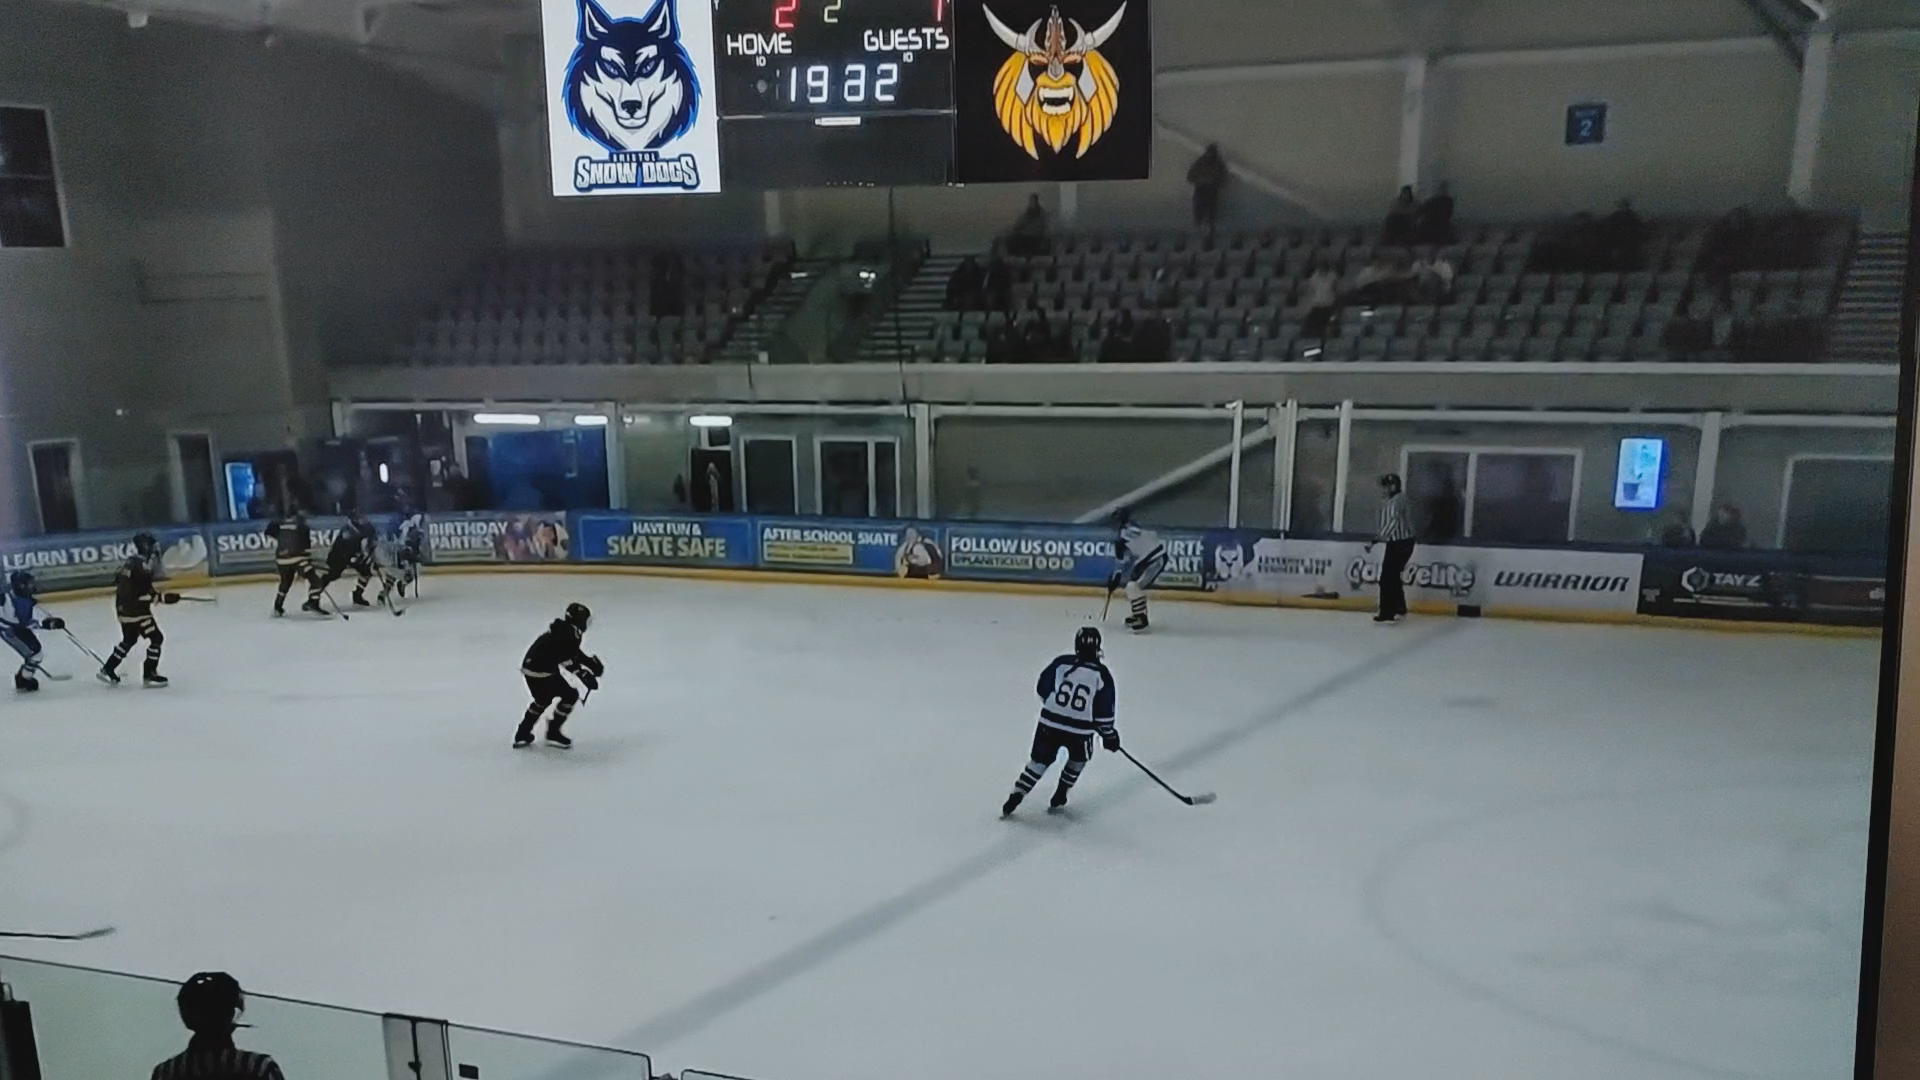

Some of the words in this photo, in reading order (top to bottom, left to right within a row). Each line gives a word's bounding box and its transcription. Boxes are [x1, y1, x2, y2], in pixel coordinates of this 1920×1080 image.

[726, 33, 792, 55] HOME
[863, 27, 950, 51] GUESTS
[612, 152, 657, 162] BRISTOL
[576, 157, 637, 189] SNOW
[642, 154, 699, 187] DOGS
[428, 521, 508, 536] BIRTHDAY
[632, 522, 664, 535] HAVE
[666, 523, 691, 537] FUN
[763, 527, 801, 541] AFTER
[803, 529, 856, 545] SCHOOL
[857, 532, 898, 546] SKATE
[430, 536, 494, 549] PARTIES
[607, 535, 674, 557] SKATE
[677, 537, 726, 558] SAFE
[951, 536, 1018, 553] FOLLOW
[1020, 540, 1042, 555] US
[1044, 540, 1071, 556] ON
[3, 548, 68, 571] LEARN
[70, 546, 99, 564] TO
[100, 540, 139, 562] SKA
[1163, 557, 1201, 573] ART
[1494, 570, 1630, 592] WARRIOR
[1055, 681, 1091, 712] 66
